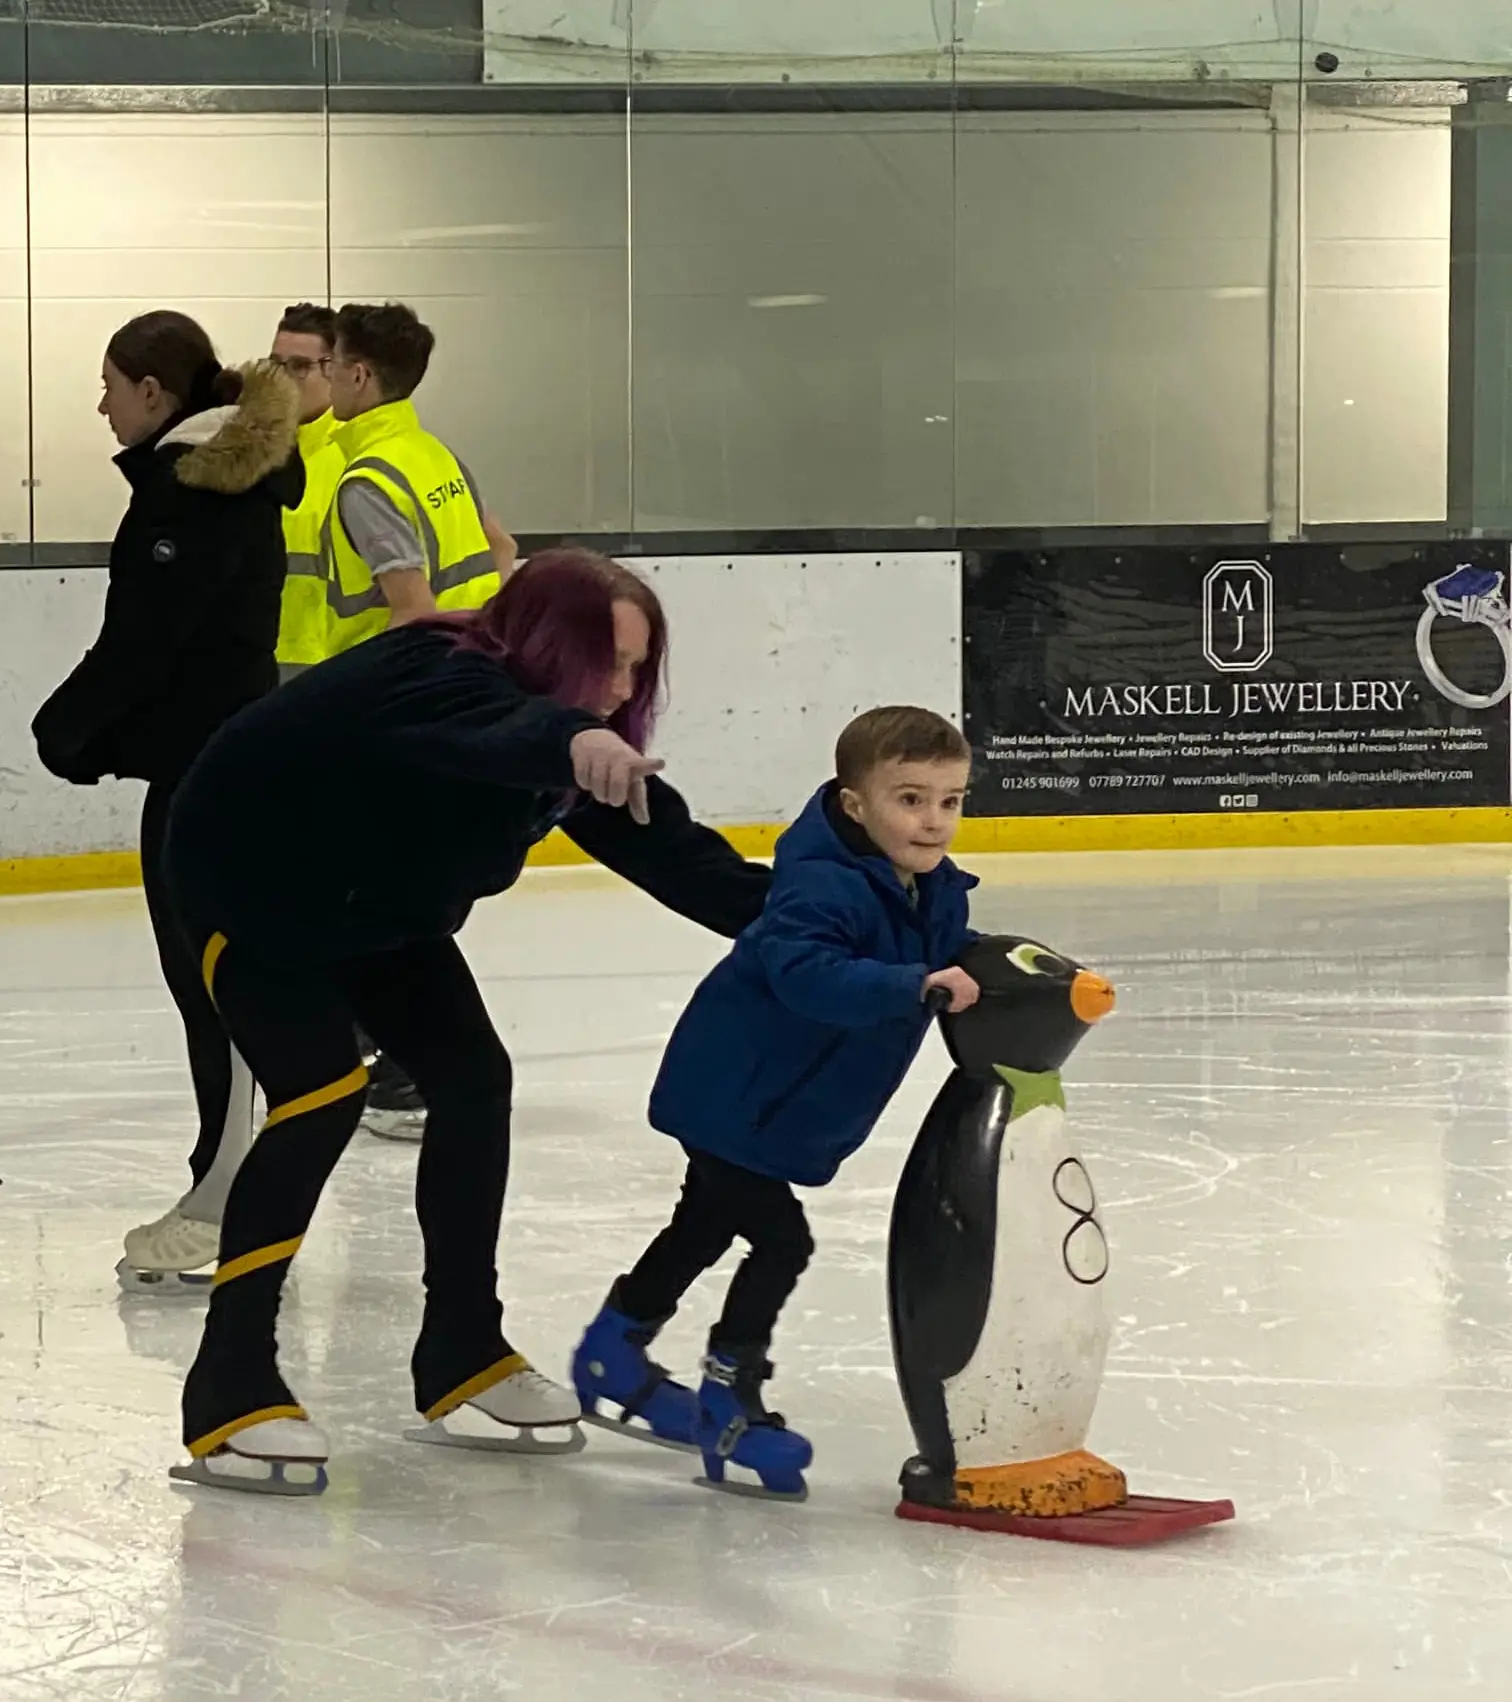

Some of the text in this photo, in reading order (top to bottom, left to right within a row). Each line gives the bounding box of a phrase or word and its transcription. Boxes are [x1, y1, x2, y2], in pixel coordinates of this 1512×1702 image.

[426, 478, 465, 510] STAF
[1221, 579, 1255, 612] M
[1231, 613, 1245, 653] J
[1063, 680, 1411, 719] MASKELL JEWELLERY
[986, 741, 1488, 761] Watch Repairs and Refurbs Laser Repairs CAD Design Supplier of Diamonds & all Precious Stones Valuations
[992, 734, 1017, 745] Hand
[1018, 734, 1043, 745] Made
[1045, 734, 1083, 747] Bespoke
[1085, 733, 1126, 745] Jewellery
[1135, 732, 1177, 745] Jewellery
[1178, 732, 1212, 744] Repairs
[1269, 729, 1279, 740] of
[1280, 730, 1315, 742] existing
[1317, 728, 1358, 741] Jewellery
[1369, 728, 1406, 739] Antique
[1407, 727, 1449, 739] Jewellery
[1448, 726, 1483, 738] Repairs
[1002, 769, 1474, 790] 01245 901699 07789 727707 www.maskelljewellery.com info@maskelljewellery.com
[1052, 1157, 1109, 1285] 8
